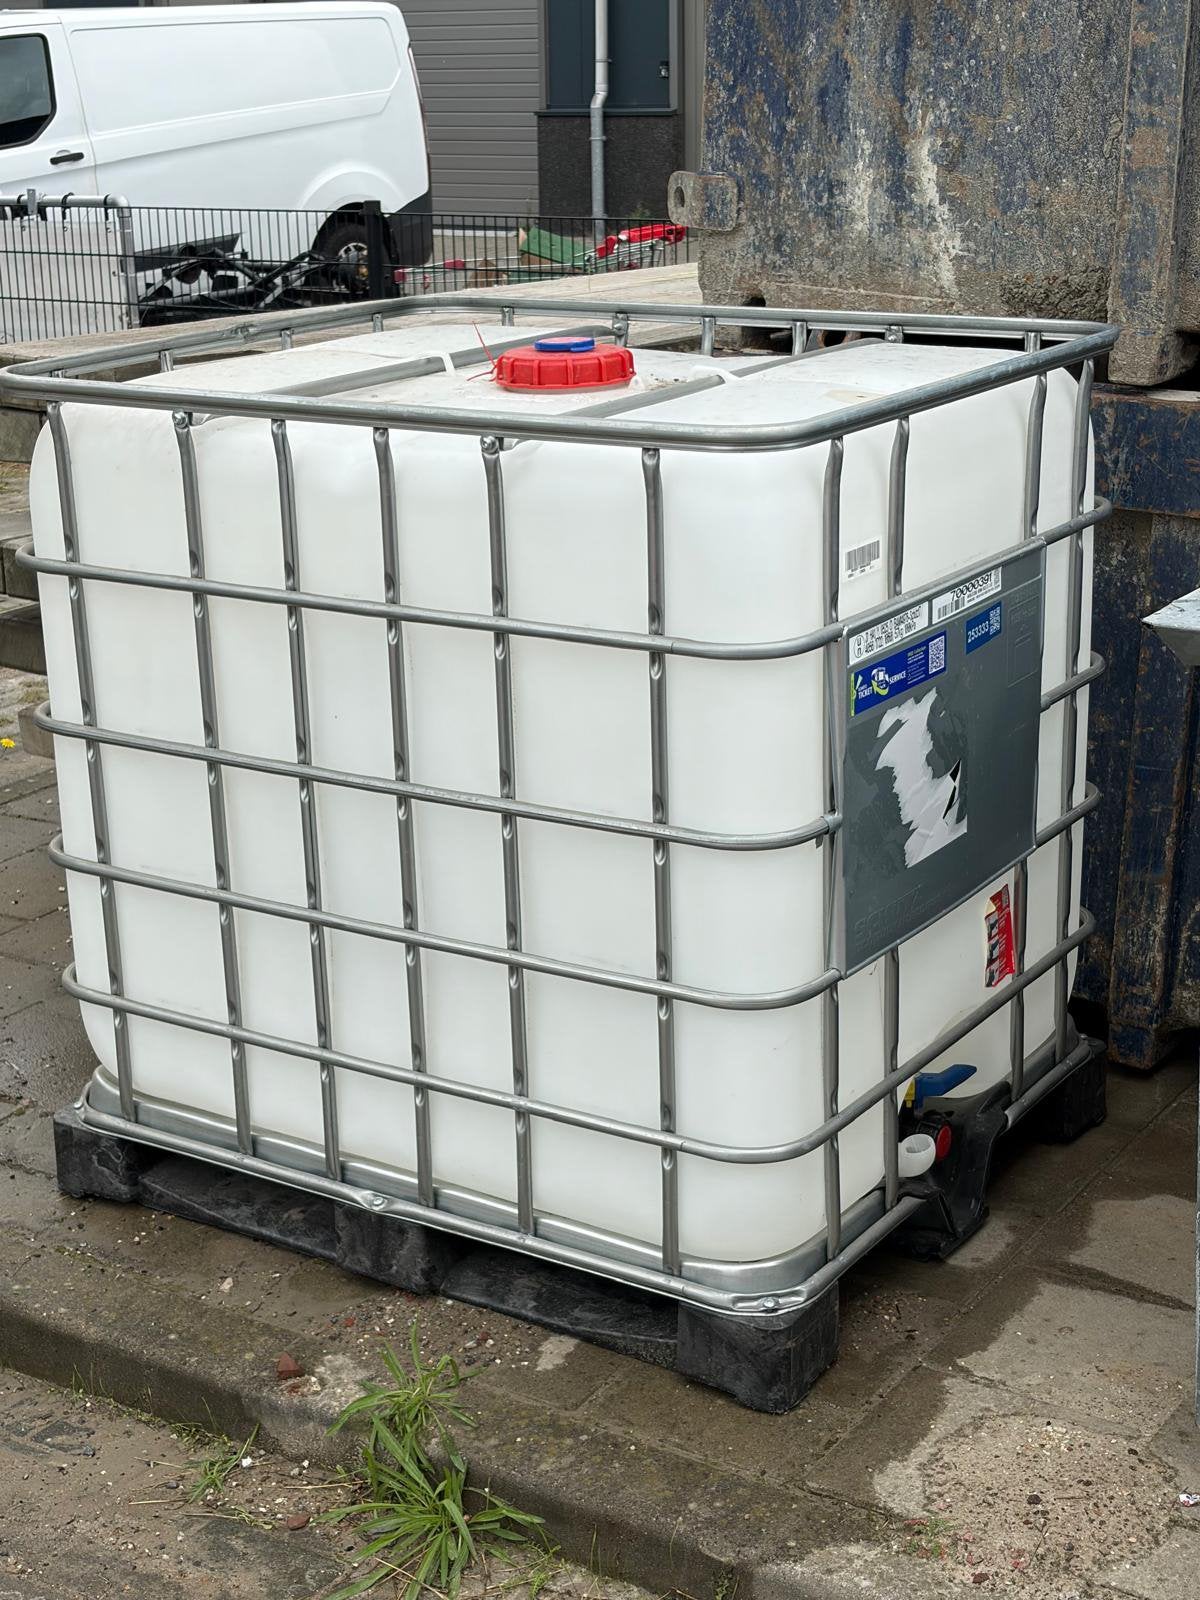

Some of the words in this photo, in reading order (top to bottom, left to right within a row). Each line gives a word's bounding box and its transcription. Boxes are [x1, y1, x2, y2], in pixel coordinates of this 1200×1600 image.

[950, 572, 993, 602] 70000391
[889, 670, 907, 685] SERVICE
[858, 686, 873, 700] TICKET
